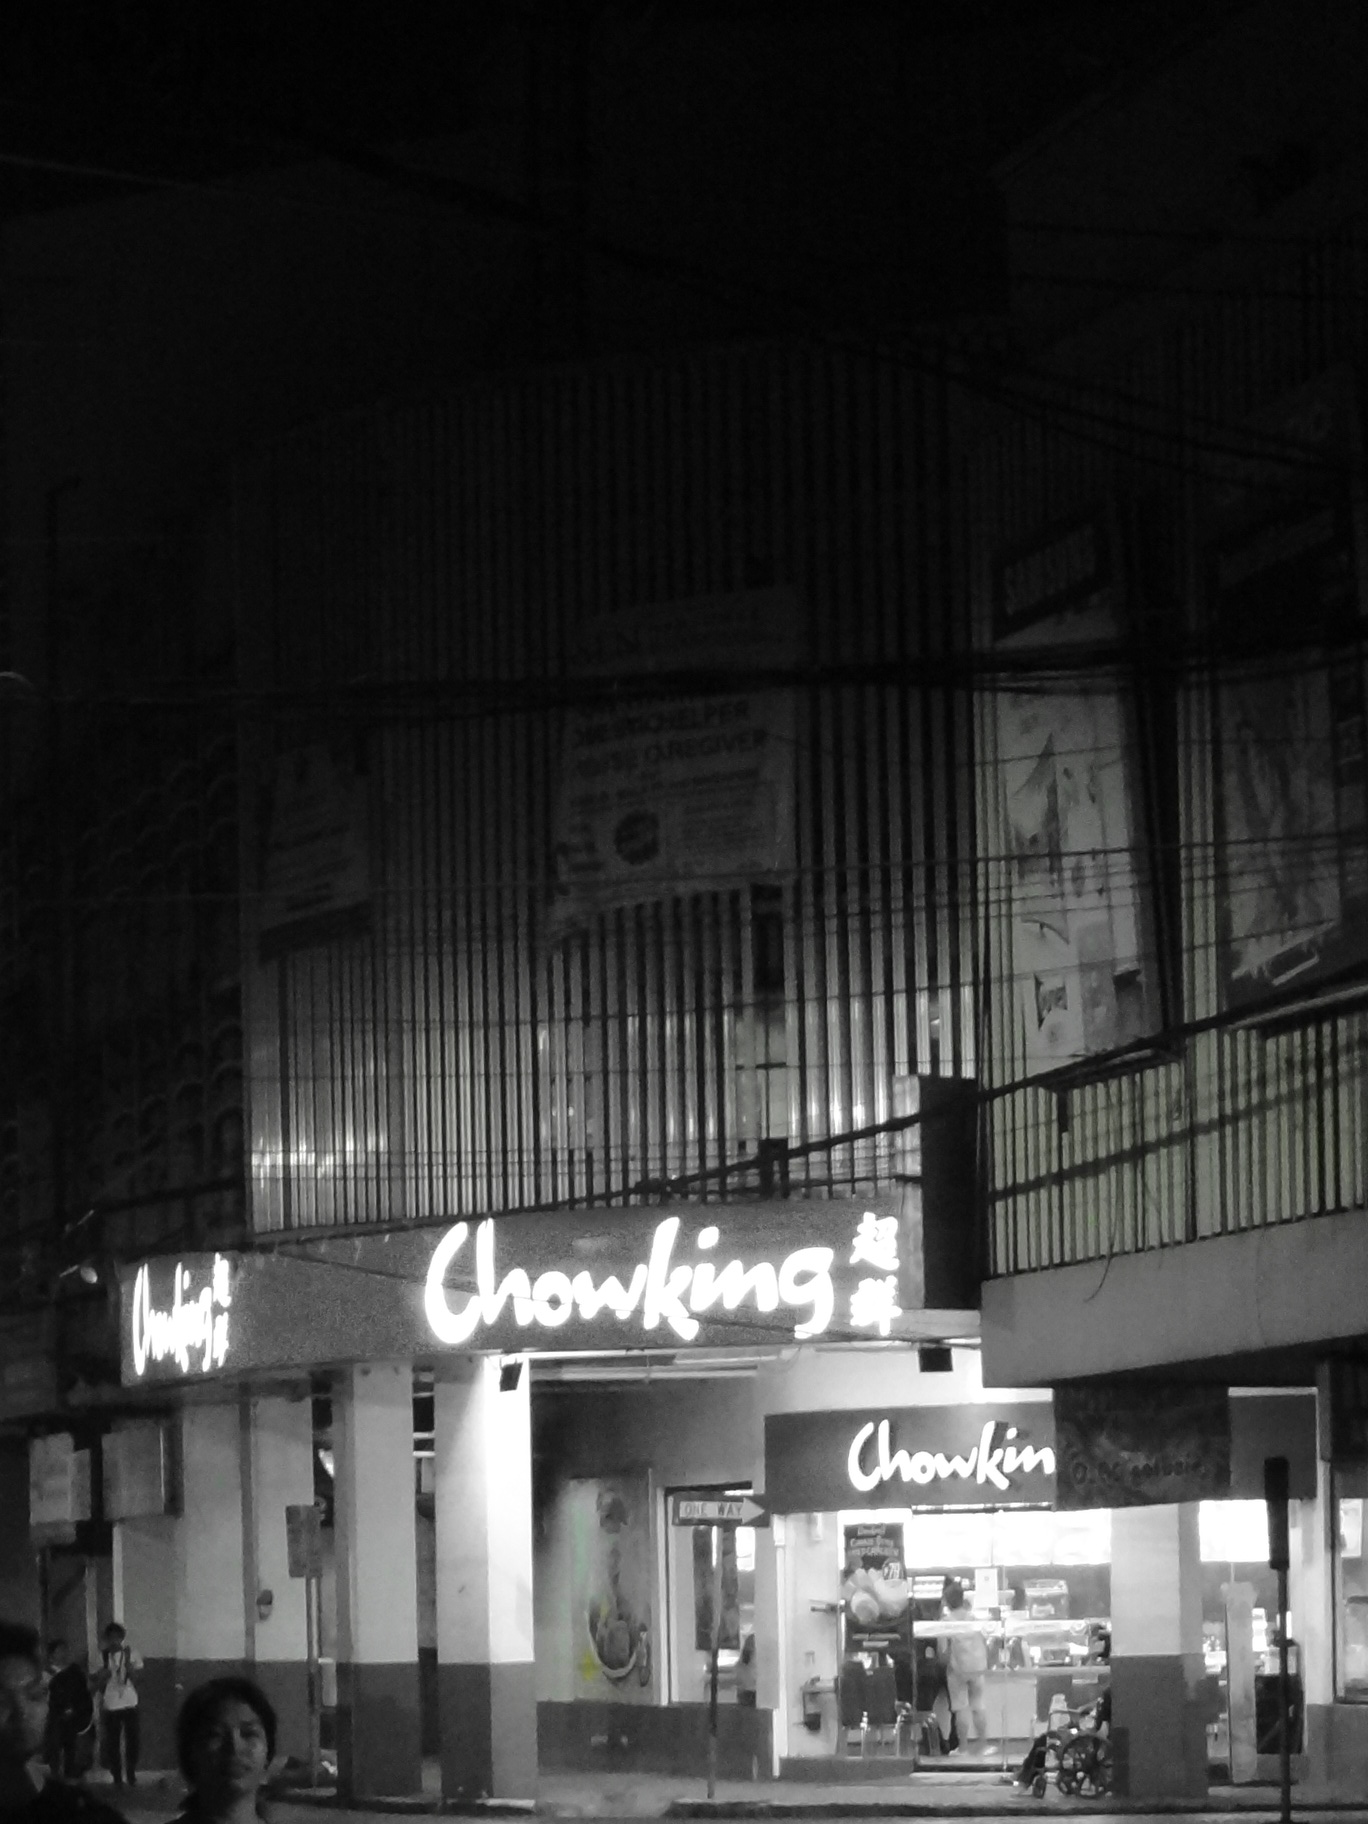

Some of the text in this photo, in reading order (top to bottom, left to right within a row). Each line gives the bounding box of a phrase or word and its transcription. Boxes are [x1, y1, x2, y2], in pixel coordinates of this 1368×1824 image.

[424, 1216, 835, 1345] Chowking
[684, 1501, 743, 1518] ONE WAY
